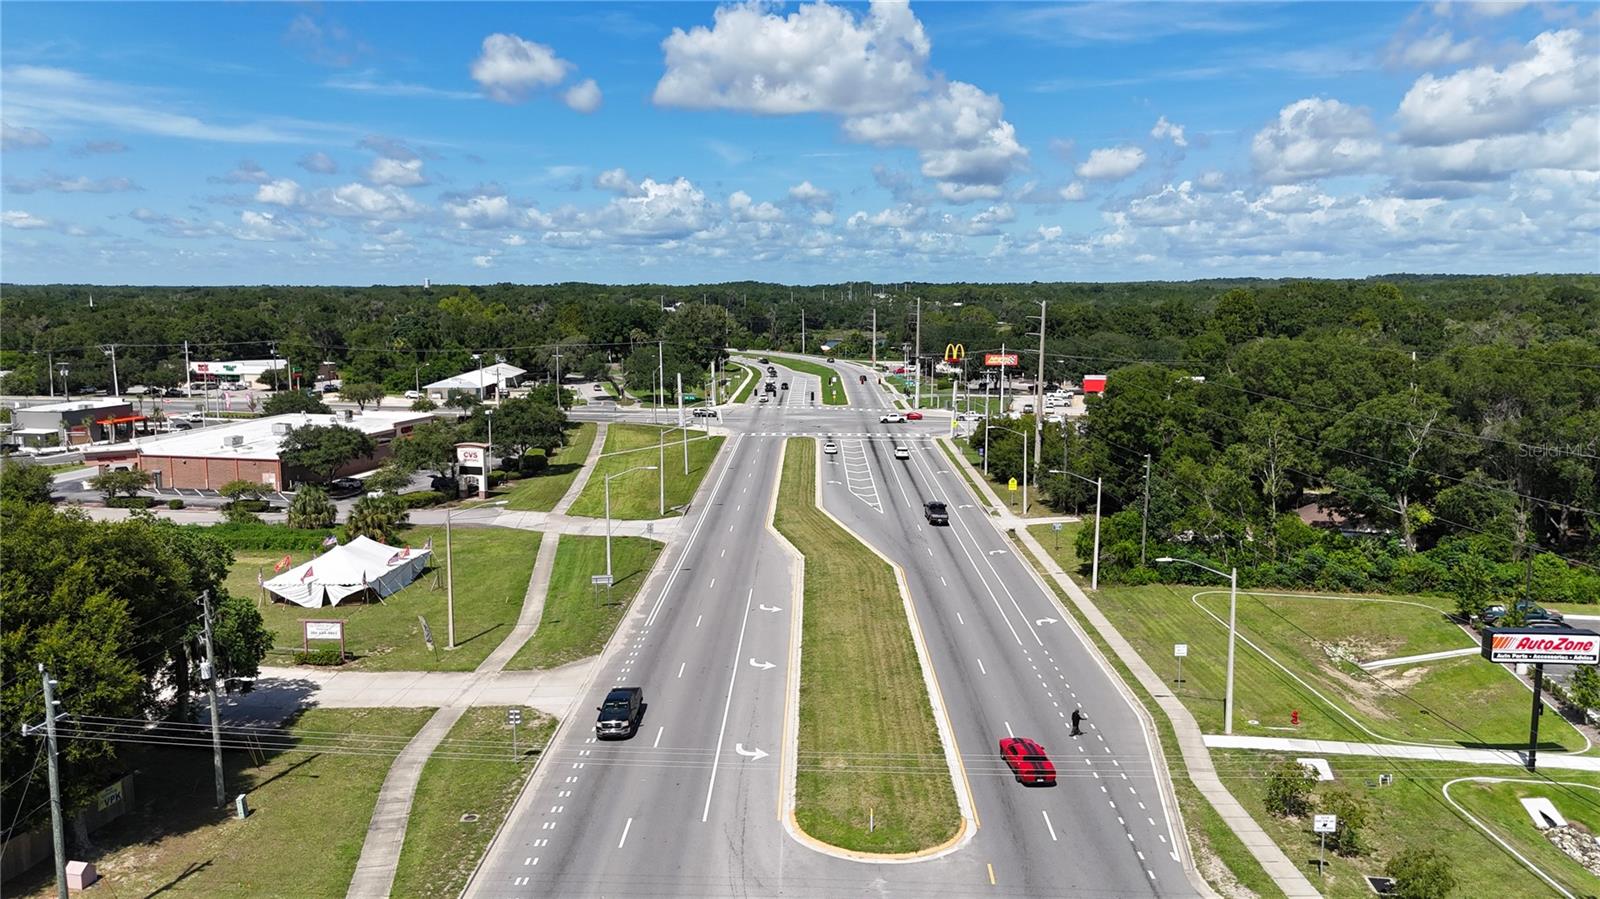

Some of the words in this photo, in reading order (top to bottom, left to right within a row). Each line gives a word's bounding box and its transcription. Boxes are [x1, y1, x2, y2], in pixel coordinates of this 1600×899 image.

[463, 451, 478, 459] CVS
[1515, 636, 1593, 652] AutoZone
[104, 791, 123, 806] VPK
